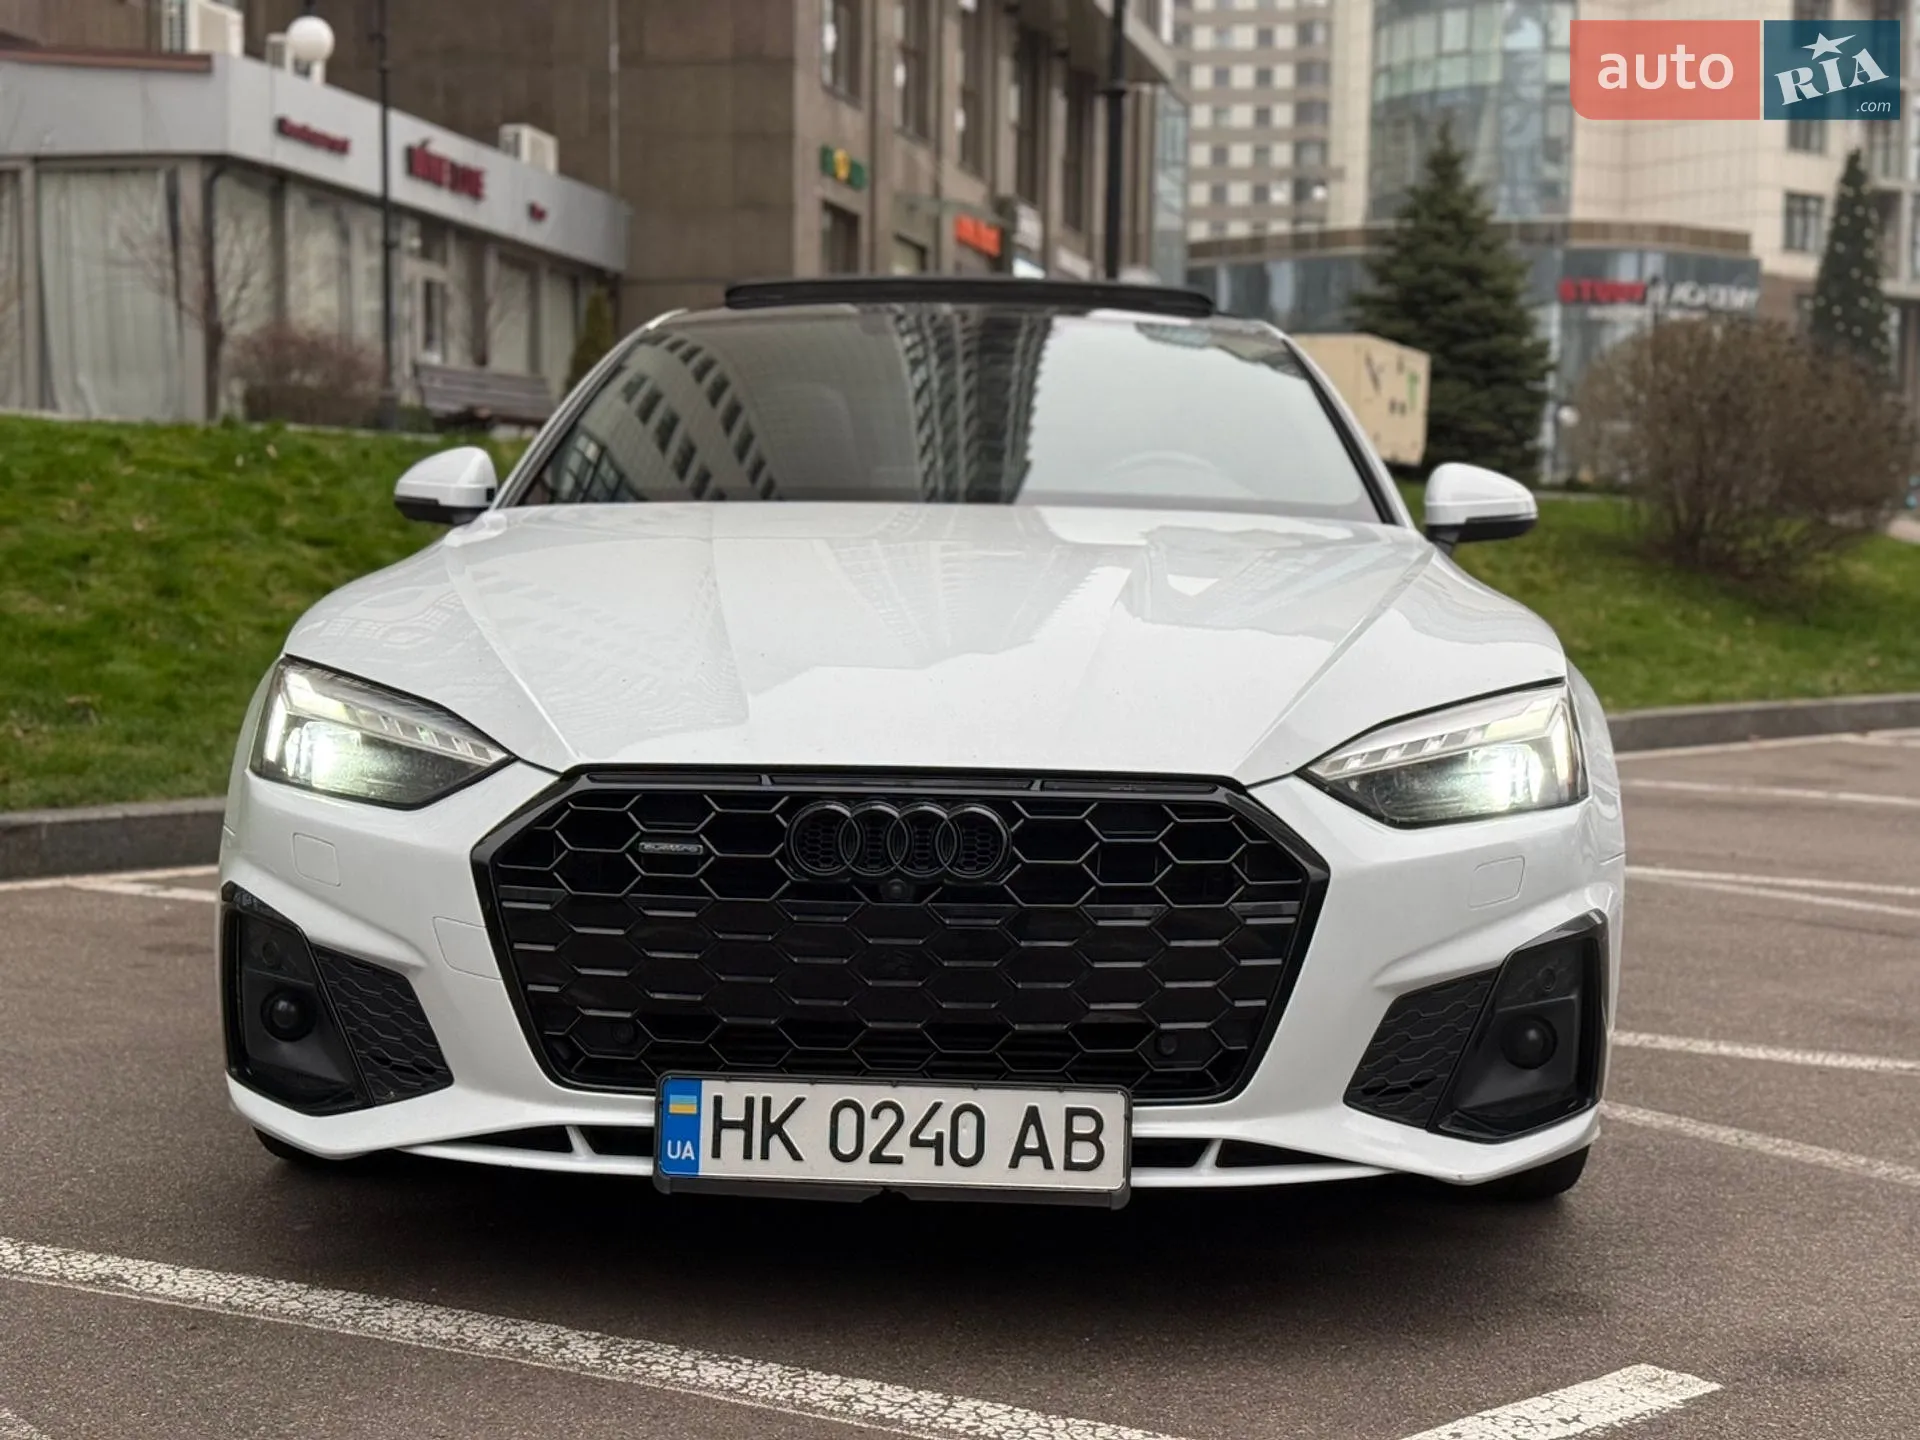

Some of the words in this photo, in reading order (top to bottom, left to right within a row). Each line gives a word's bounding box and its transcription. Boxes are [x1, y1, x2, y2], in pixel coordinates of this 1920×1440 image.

[667, 1140, 695, 1160] UA
[711, 1095, 806, 1161] HK
[829, 1099, 986, 1167] 0240
[1008, 1105, 1105, 1172] AB
